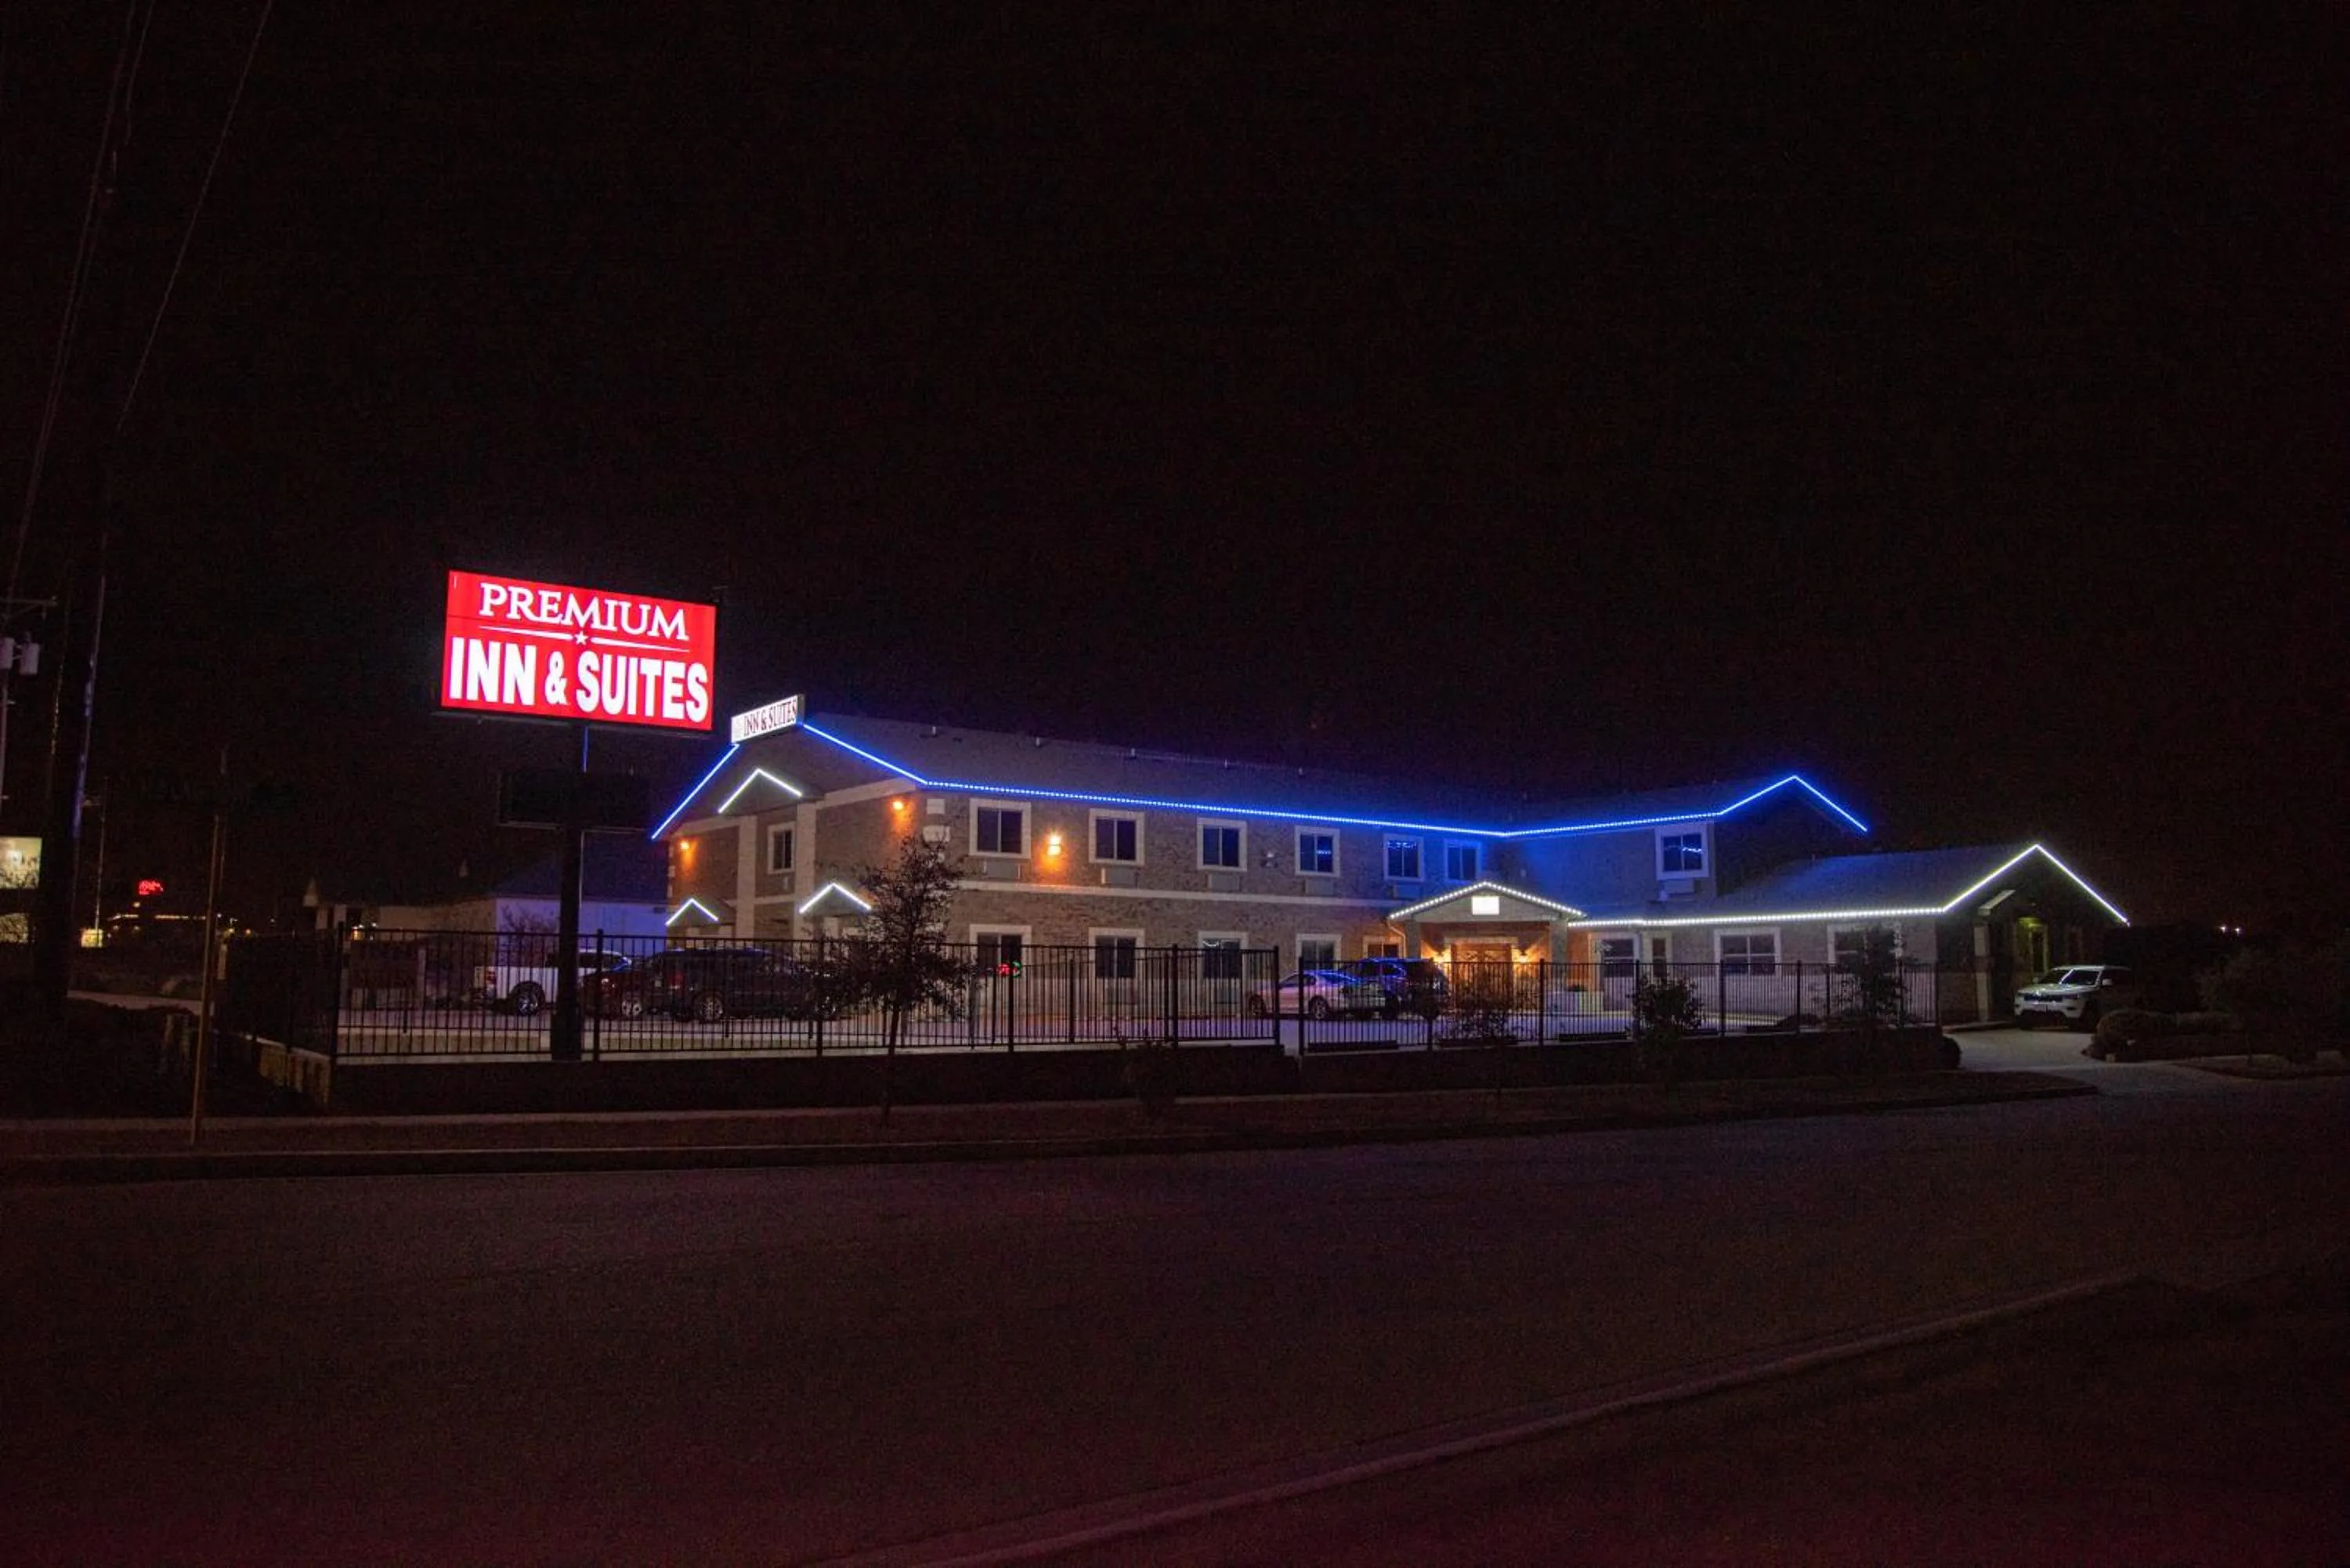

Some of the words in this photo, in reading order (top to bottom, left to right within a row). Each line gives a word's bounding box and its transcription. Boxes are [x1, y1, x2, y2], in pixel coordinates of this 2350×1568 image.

[479, 582, 689, 641] PREMIUM
[449, 636, 538, 706] INN
[544, 651, 570, 706] &
[576, 650, 709, 723] SUITES
[743, 712, 758, 736] INN
